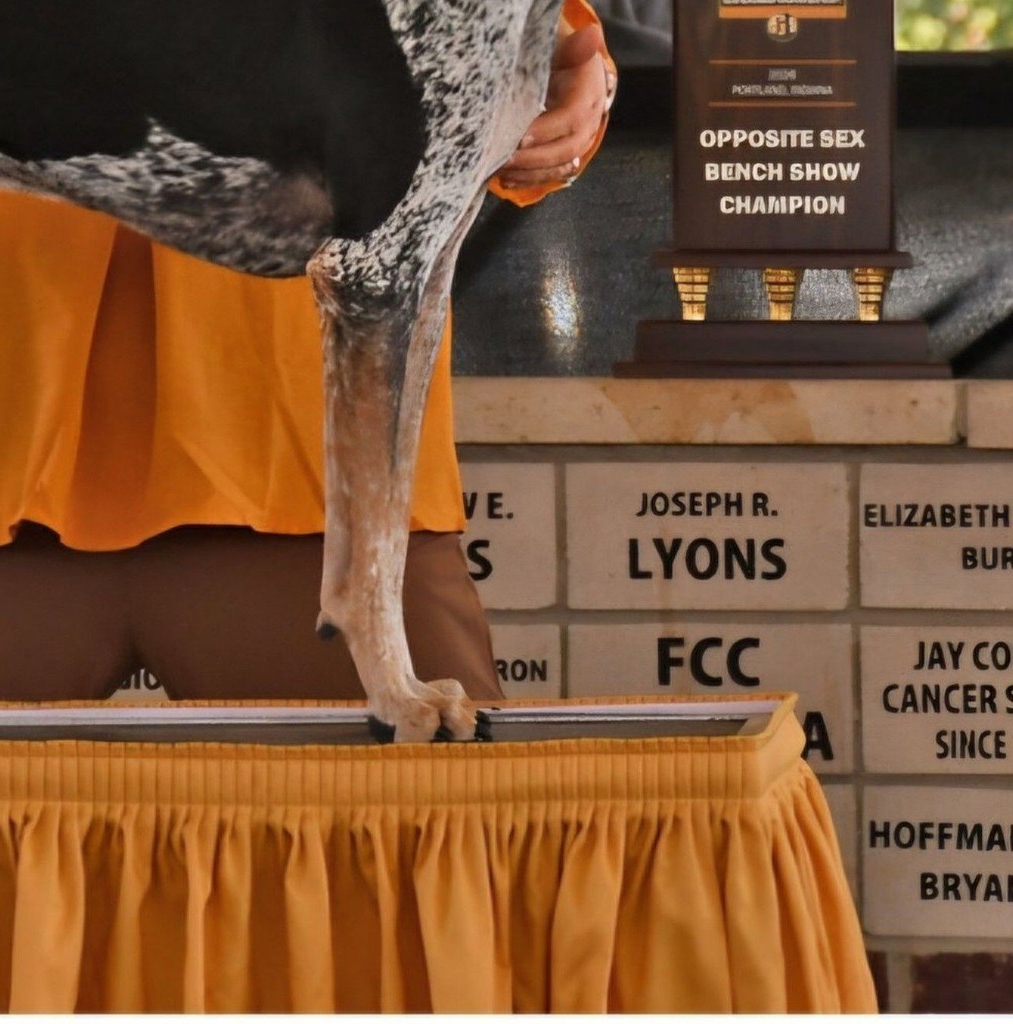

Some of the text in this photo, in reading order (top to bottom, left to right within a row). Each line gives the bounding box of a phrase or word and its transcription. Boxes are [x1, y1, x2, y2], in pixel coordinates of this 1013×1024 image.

[699, 129, 866, 149] OPPOSITE SEX
[705, 162, 861, 182] BENCH SHOW
[719, 195, 846, 215] CHAMPION
[636, 492, 779, 517] JOSEPH R.
[864, 503, 1010, 528] ELIZABETH
[628, 538, 788, 581] LYONS
[657, 637, 761, 687] FCC
[913, 641, 965, 671] JAY
[882, 683, 998, 714] CANCER
[935, 729, 1007, 759] SINCE
[869, 820, 1013, 851] HOFFMA
